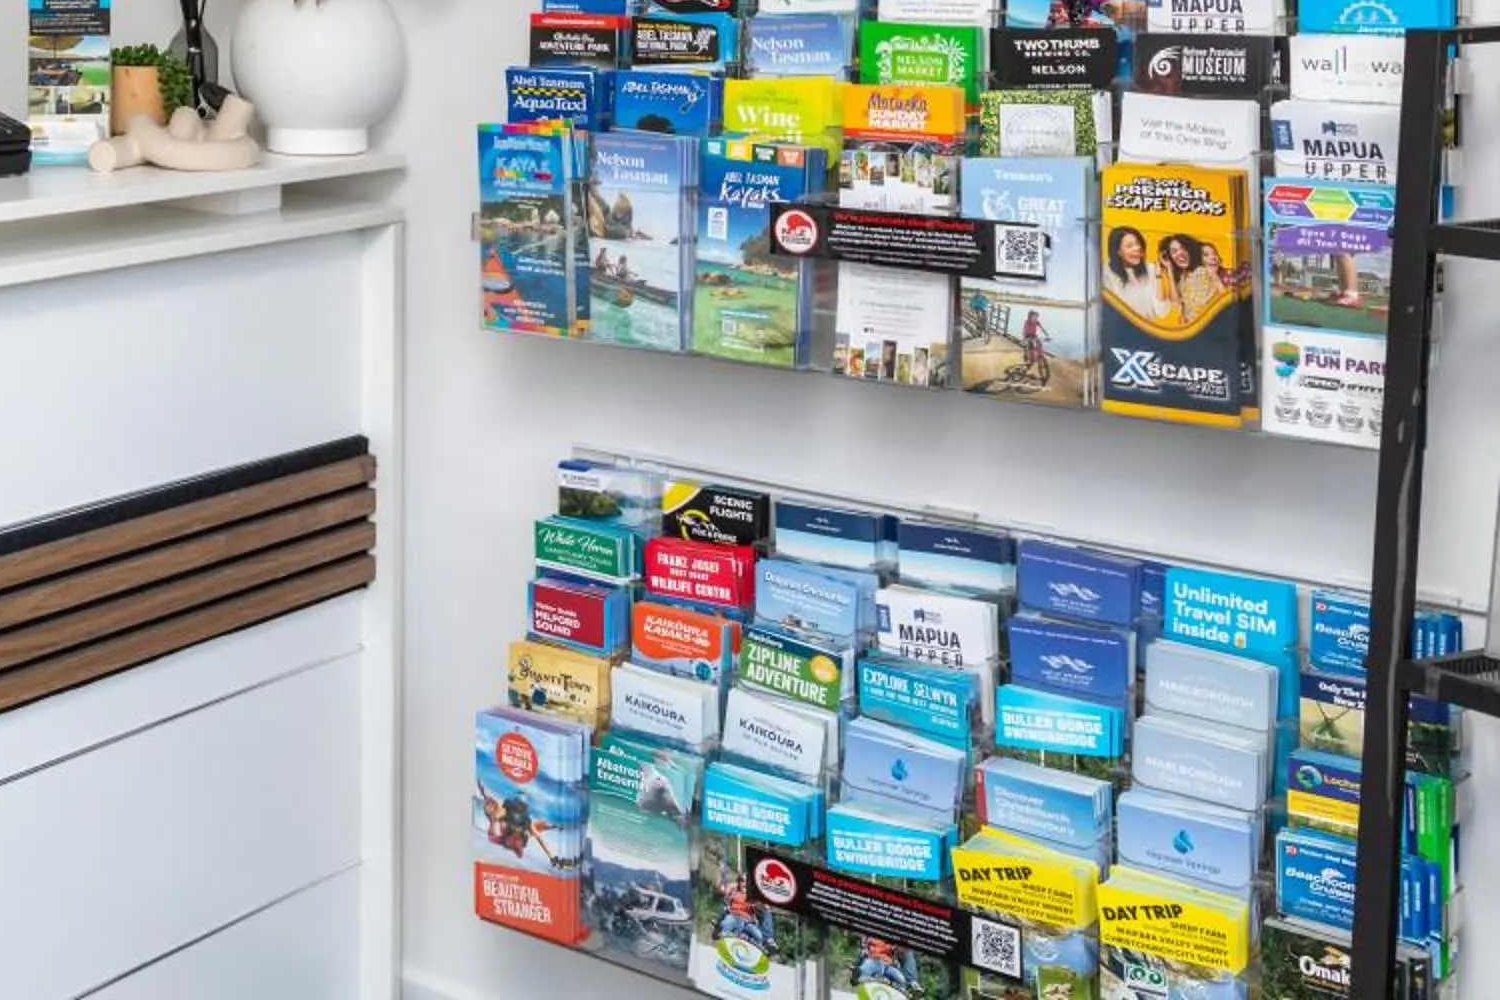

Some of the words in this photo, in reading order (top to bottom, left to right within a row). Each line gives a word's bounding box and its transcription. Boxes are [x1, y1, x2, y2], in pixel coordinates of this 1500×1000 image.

[1171, 18, 1244, 32] UPPER
[752, 37, 805, 51] Nelson
[1013, 39, 1048, 51] TWO
[1051, 38, 1100, 49] THUMB
[771, 50, 830, 63] Tasman
[896, 55, 943, 67] NELSON
[897, 65, 942, 77] MARKET
[1031, 64, 1086, 75] NELSON
[1182, 56, 1246, 75] MUSEUM
[512, 75, 537, 87] Abel
[539, 77, 585, 89] Tasman
[737, 105, 801, 128] Wine
[868, 110, 927, 120] SUNDAY
[868, 119, 925, 130] MARKET
[596, 151, 645, 168] Nelson
[612, 169, 668, 184] Tasman
[745, 172, 780, 185] TASMAN
[993, 168, 1053, 183] Tasman's
[1304, 162, 1387, 179] UPPER
[720, 182, 780, 208] Kayaks
[1116, 183, 1207, 200] PREMIER
[1017, 195, 1067, 210] GREAT
[1108, 195, 1166, 211] ESCAPE
[1168, 198, 1225, 216] ROOMS
[1305, 353, 1341, 370] FUN
[714, 495, 753, 511] SCENIC
[710, 505, 753, 522] FLIGHTS
[657, 551, 688, 569] FRANZ
[691, 559, 719, 573] JOSEF
[651, 576, 692, 594] WILDLIFE
[694, 584, 731, 600] CENTRE
[1173, 582, 1269, 613] Unlimited
[535, 609, 581, 629] MILFORD
[1173, 600, 1232, 627] Travel
[1236, 614, 1277, 635] SIM
[535, 619, 571, 637] SOUND
[1173, 618, 1230, 643] inside
[747, 643, 802, 677] ZIPLINE
[747, 661, 828, 705] ADVENTURE
[863, 667, 910, 695] EXPLORE
[913, 681, 957, 706] SELWYN
[1318, 681, 1341, 696] Only
[1003, 712, 1053, 730] BULLER
[1056, 719, 1104, 736] GORGE
[1004, 727, 1097, 749] SWINGBRIDGE
[708, 797, 749, 815] BULLER
[751, 805, 791, 825] GORGE
[708, 809, 786, 837] SWINGBRIDGE
[833, 836, 883, 855] BULLER
[886, 842, 932, 859] GORGE
[835, 849, 926, 872] SWINGBRIDGE
[959, 867, 991, 881] DAY
[993, 866, 1033, 881] TRIP
[483, 879, 543, 904] BEAUTIFUL
[493, 899, 552, 924] STRANGER
[1102, 906, 1137, 921] DAY
[1140, 904, 1183, 920] TRIP
